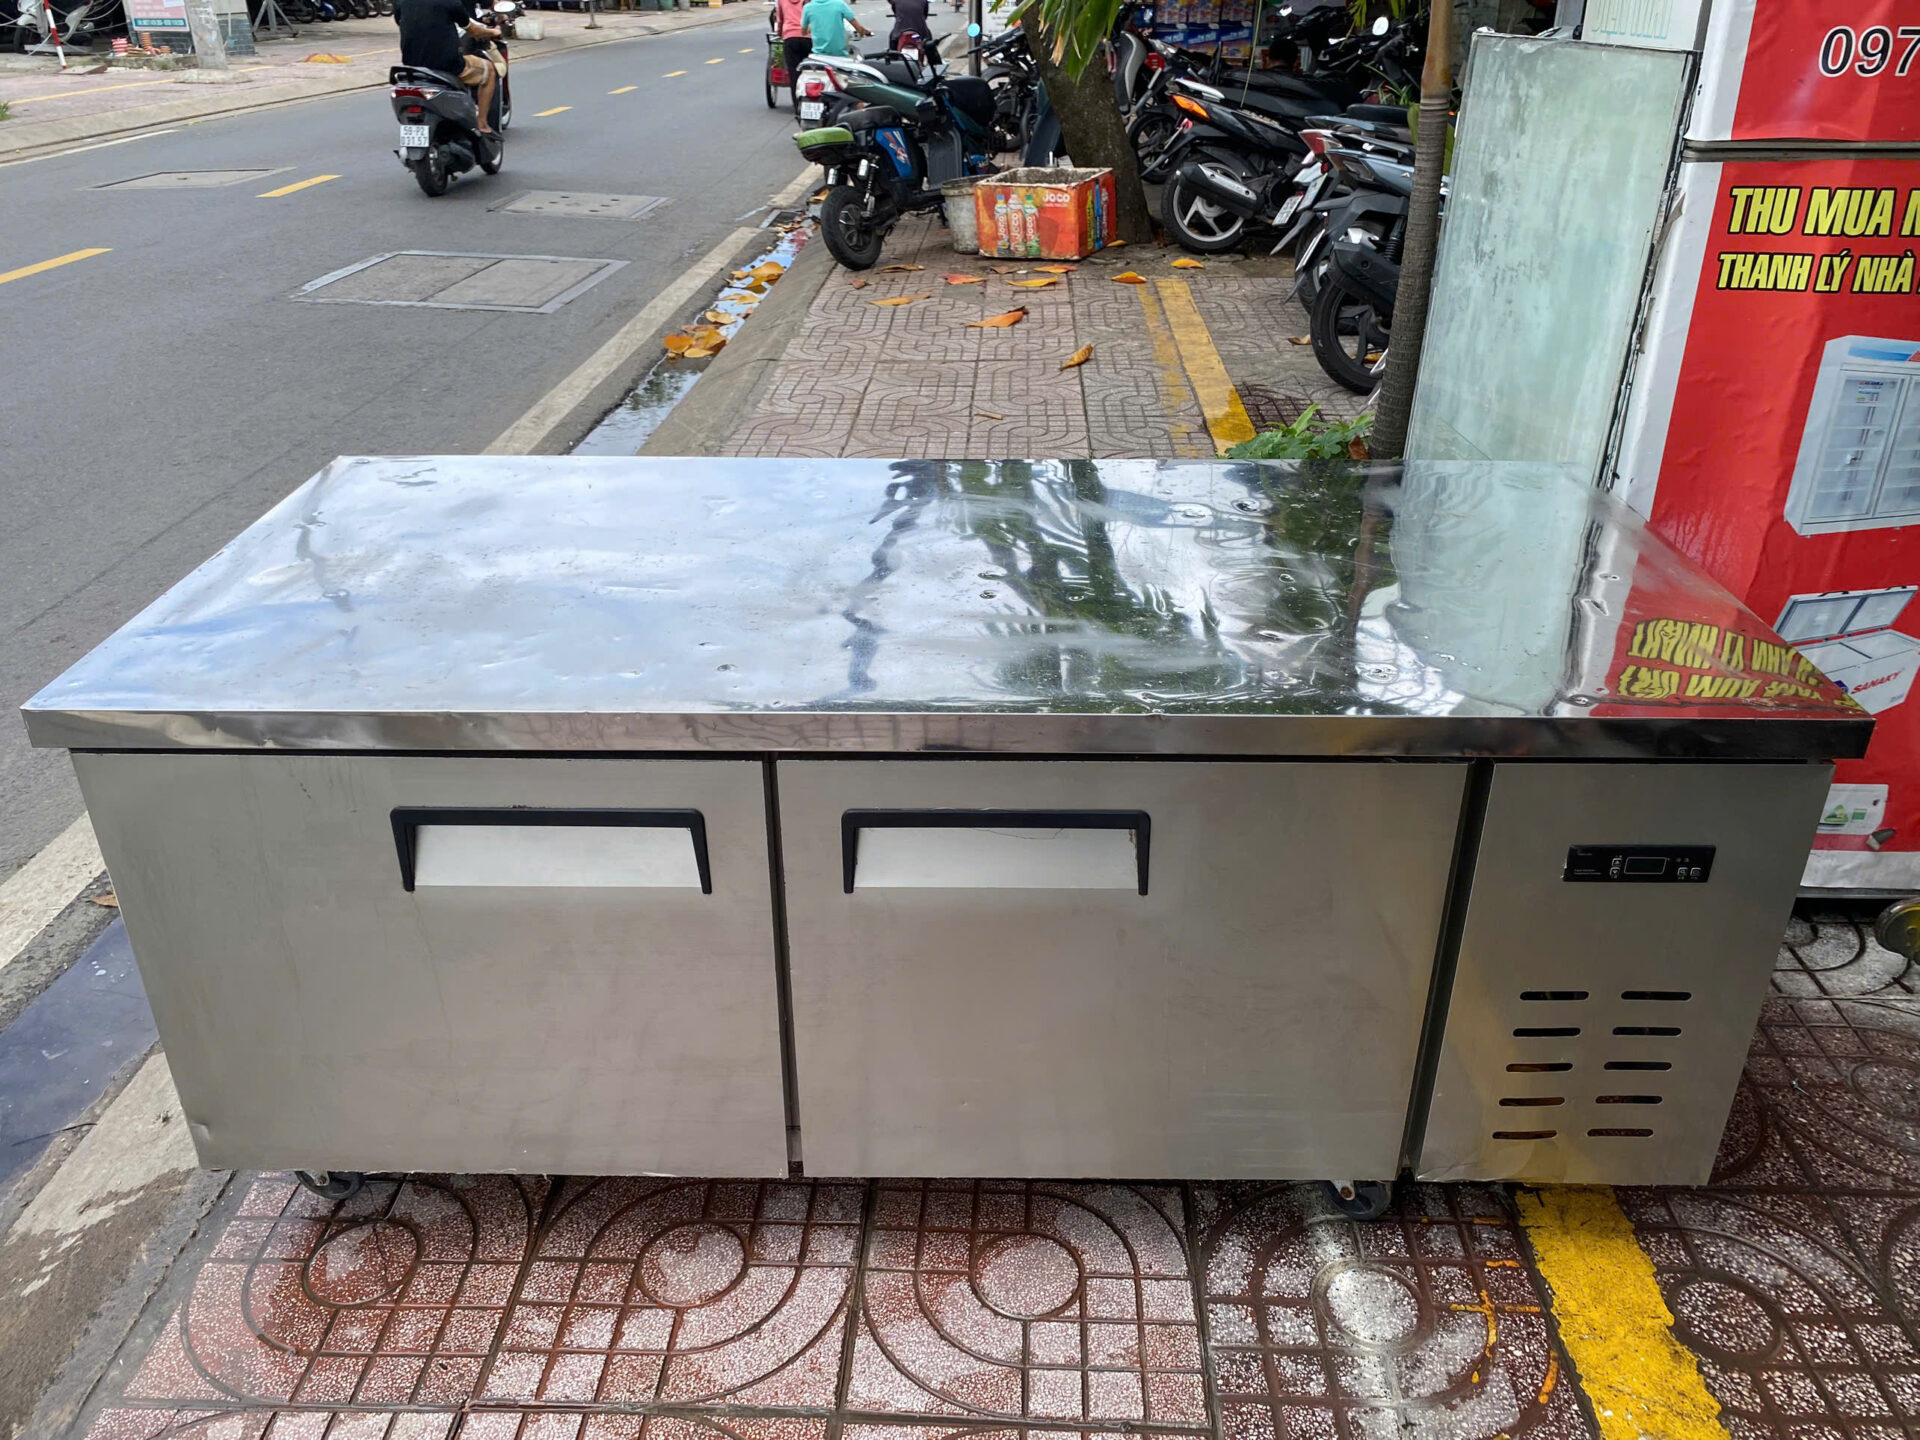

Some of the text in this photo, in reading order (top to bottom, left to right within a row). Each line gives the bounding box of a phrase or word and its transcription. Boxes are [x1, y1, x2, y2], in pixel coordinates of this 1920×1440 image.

[1819, 25, 1920, 77] 097
[1728, 186, 1801, 235] THU
[1802, 187, 1896, 237] MUA
[1716, 252, 1814, 292] THANH
[1813, 248, 1851, 293] LÝ
[1850, 249, 1916, 294] NHÀ
